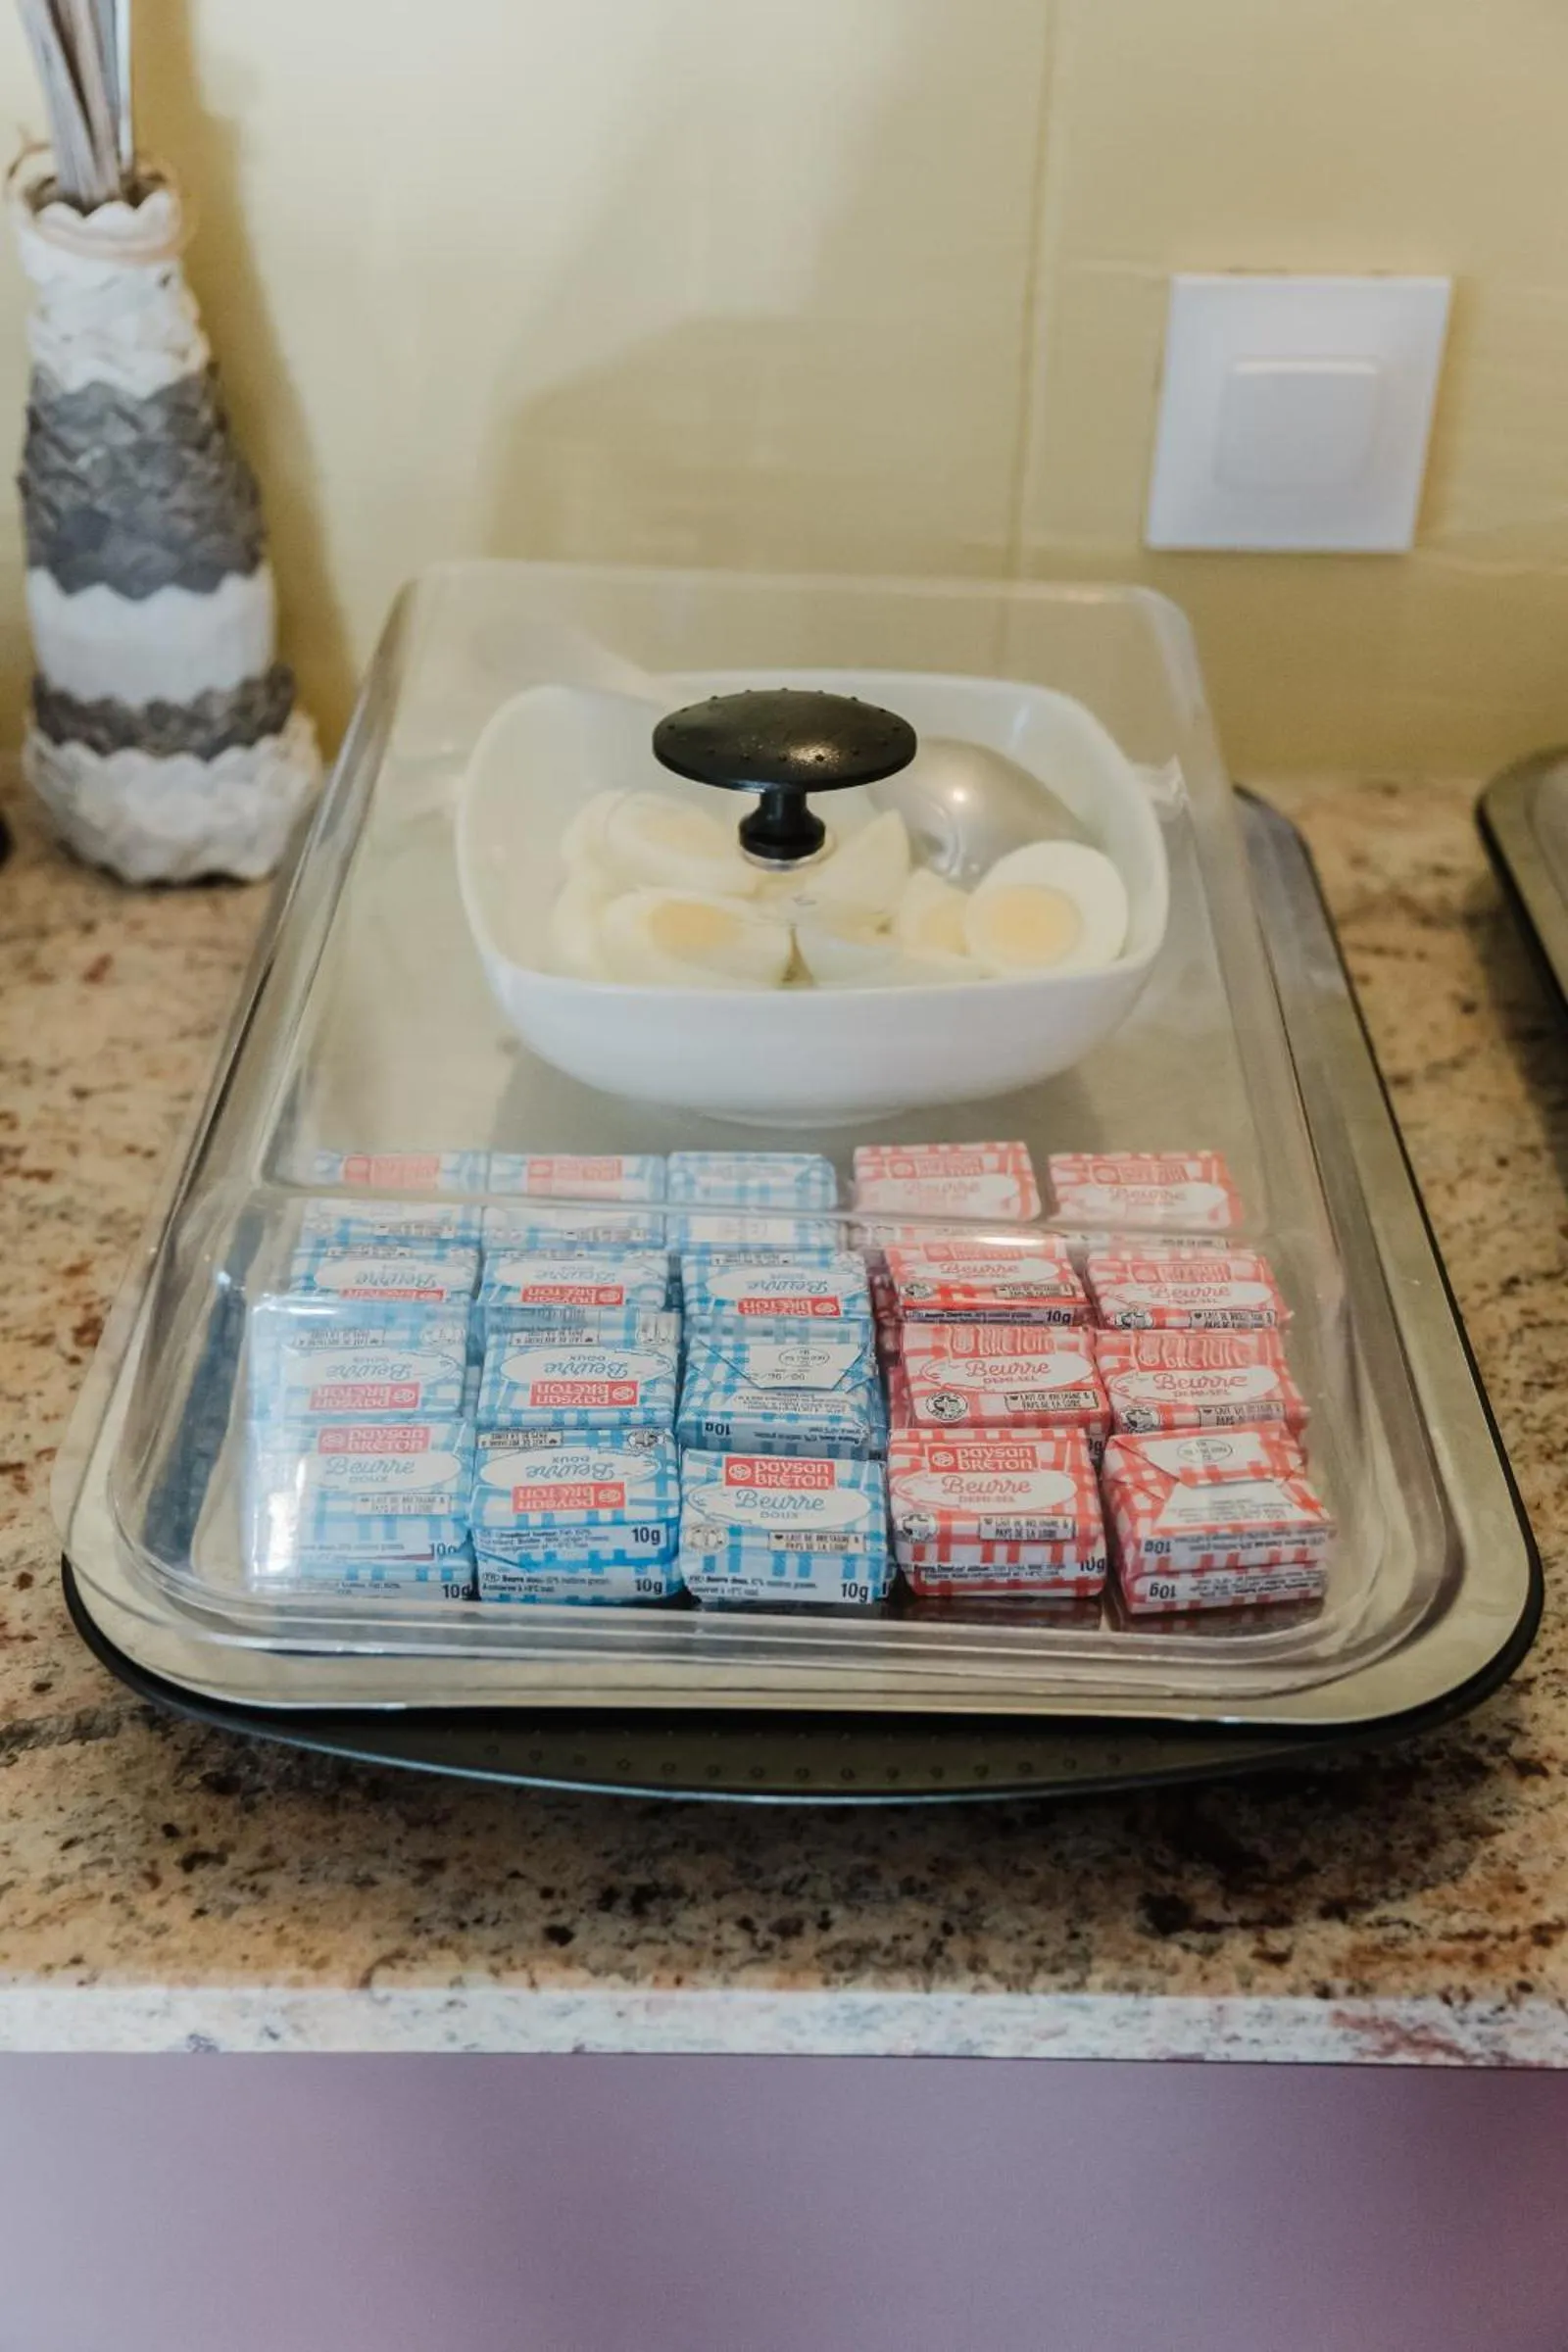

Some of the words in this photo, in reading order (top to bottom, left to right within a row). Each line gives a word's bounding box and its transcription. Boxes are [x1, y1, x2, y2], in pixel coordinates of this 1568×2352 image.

[326, 1363, 413, 1382] Beurre
[544, 1361, 628, 1380] Beurre
[965, 1358, 1052, 1377] Beurre
[1153, 1373, 1248, 1391] Beurre
[958, 1446, 1032, 1459] paysan
[326, 1455, 416, 1475] Beurre
[525, 1462, 614, 1482] Beurre
[755, 1460, 829, 1475] paysan
[941, 1474, 1033, 1494] Beurre
[735, 1489, 825, 1510] Beurre
[632, 1527, 662, 1545] 10g
[636, 1579, 662, 1595] 10g
[841, 1583, 869, 1603] 10g
[1150, 1582, 1177, 1598] 10g
